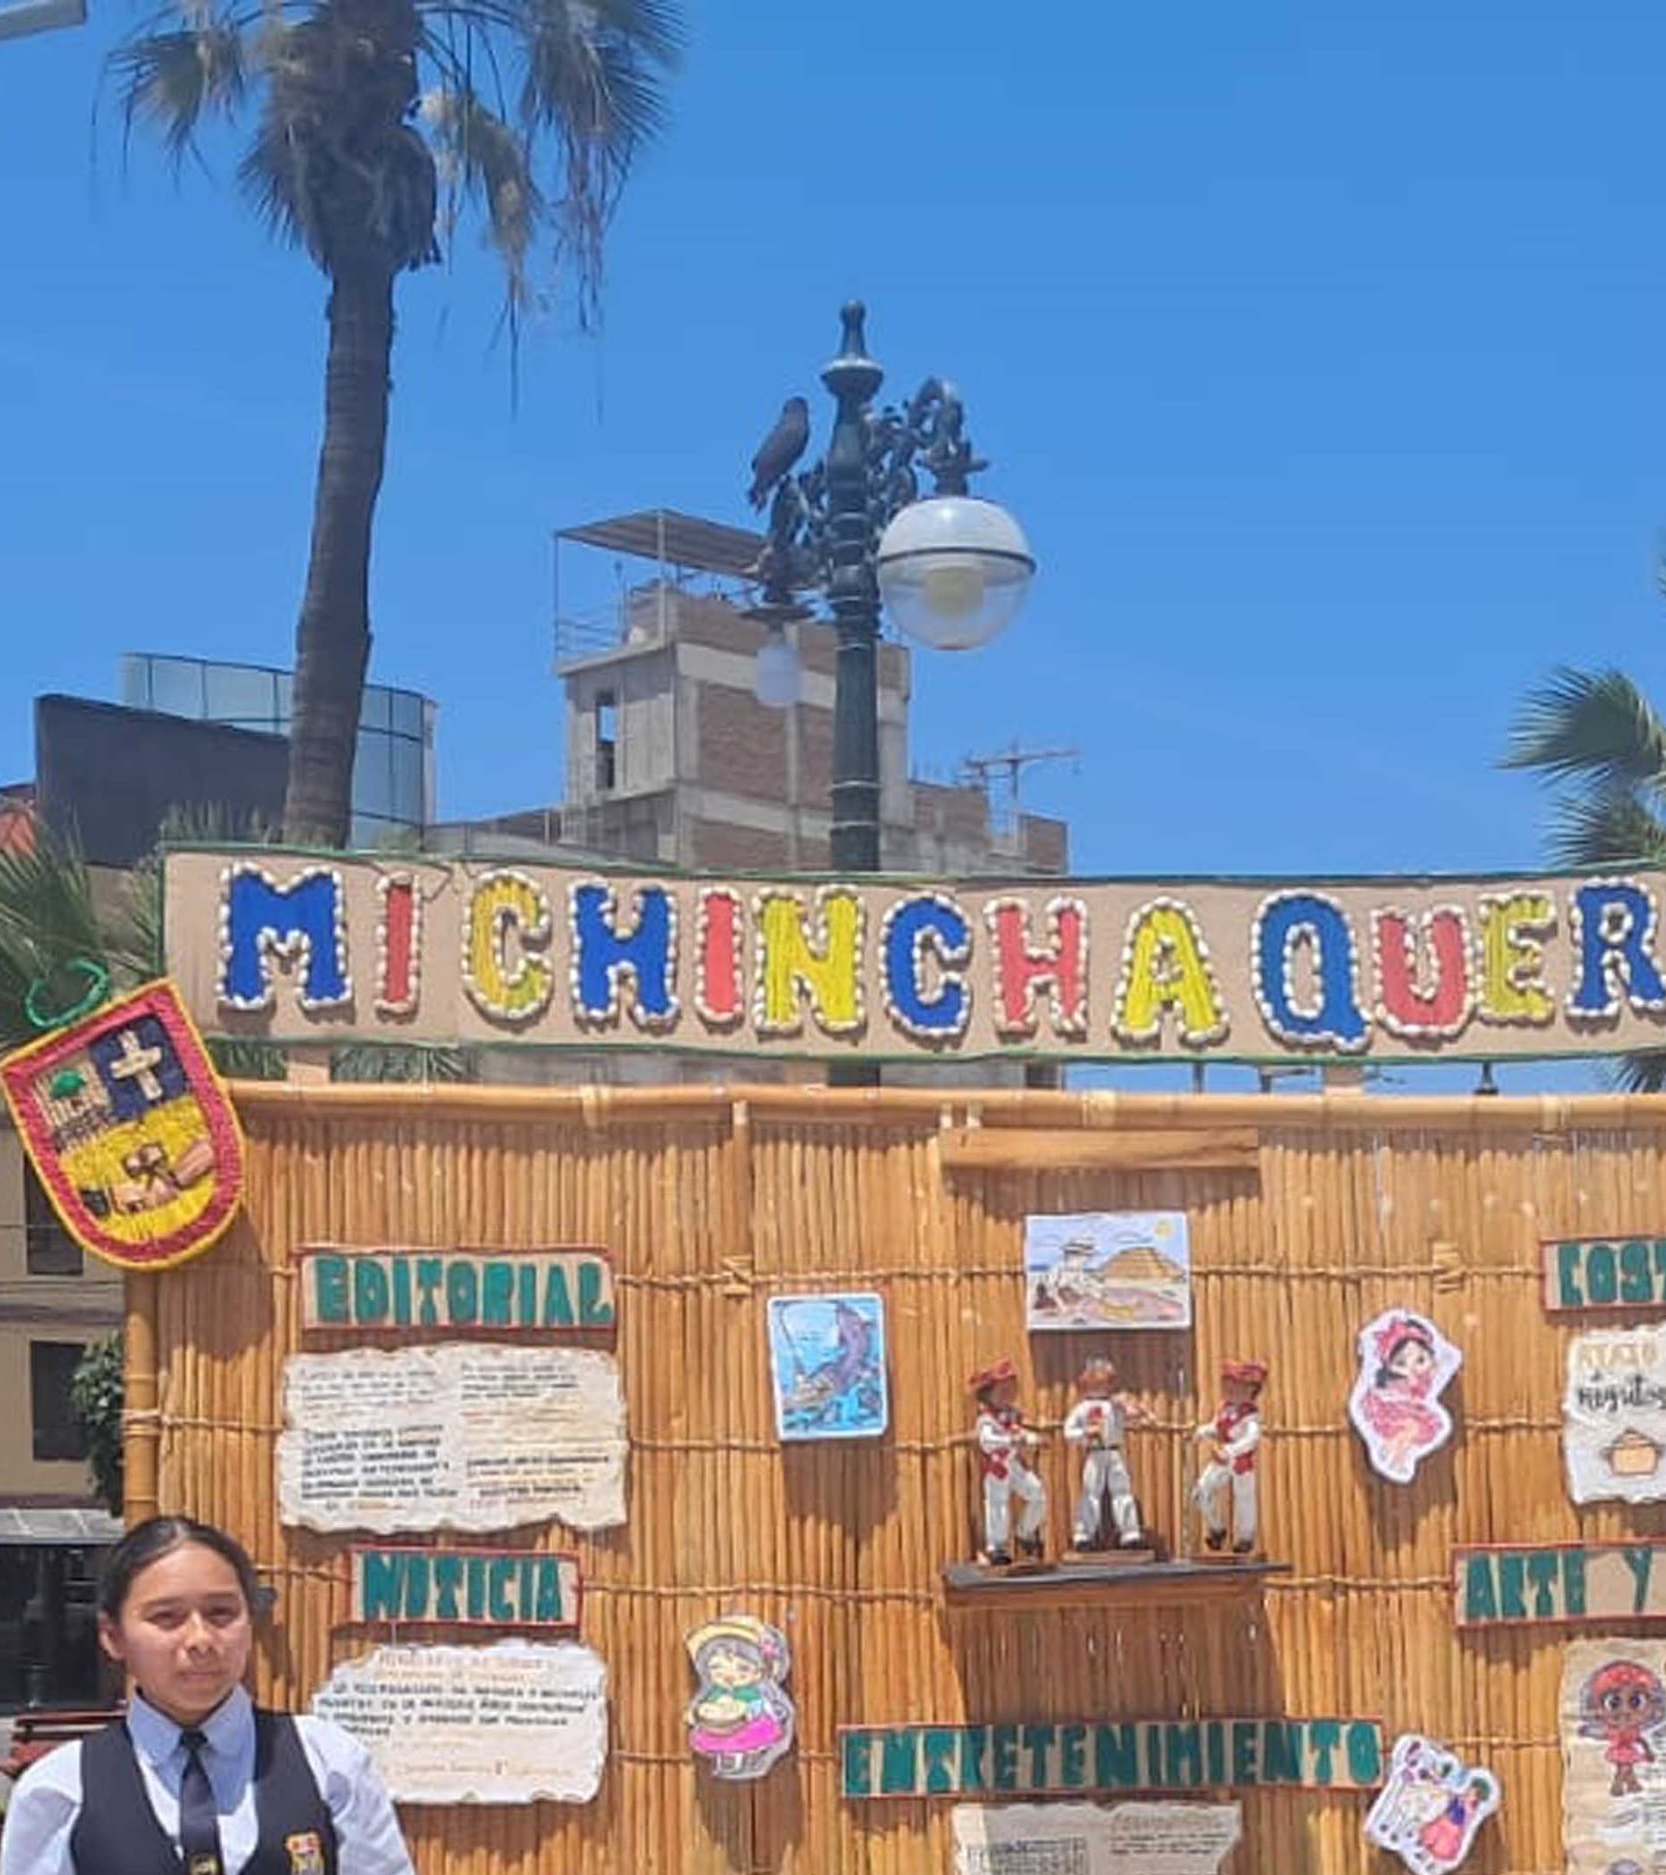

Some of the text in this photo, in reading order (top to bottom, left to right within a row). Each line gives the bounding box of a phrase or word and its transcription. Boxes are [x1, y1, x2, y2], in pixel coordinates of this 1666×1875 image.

[217, 860, 423, 1015] MI
[461, 870, 1230, 1042] CHINCHA
[314, 1252, 614, 1327] EDITORIAL
[362, 1549, 564, 1621] NOTICIA
[1464, 1549, 1587, 1621] ARTE
[1623, 1546, 1653, 1613] Y
[841, 1721, 1382, 1796] ENTRETENIMIENTO
